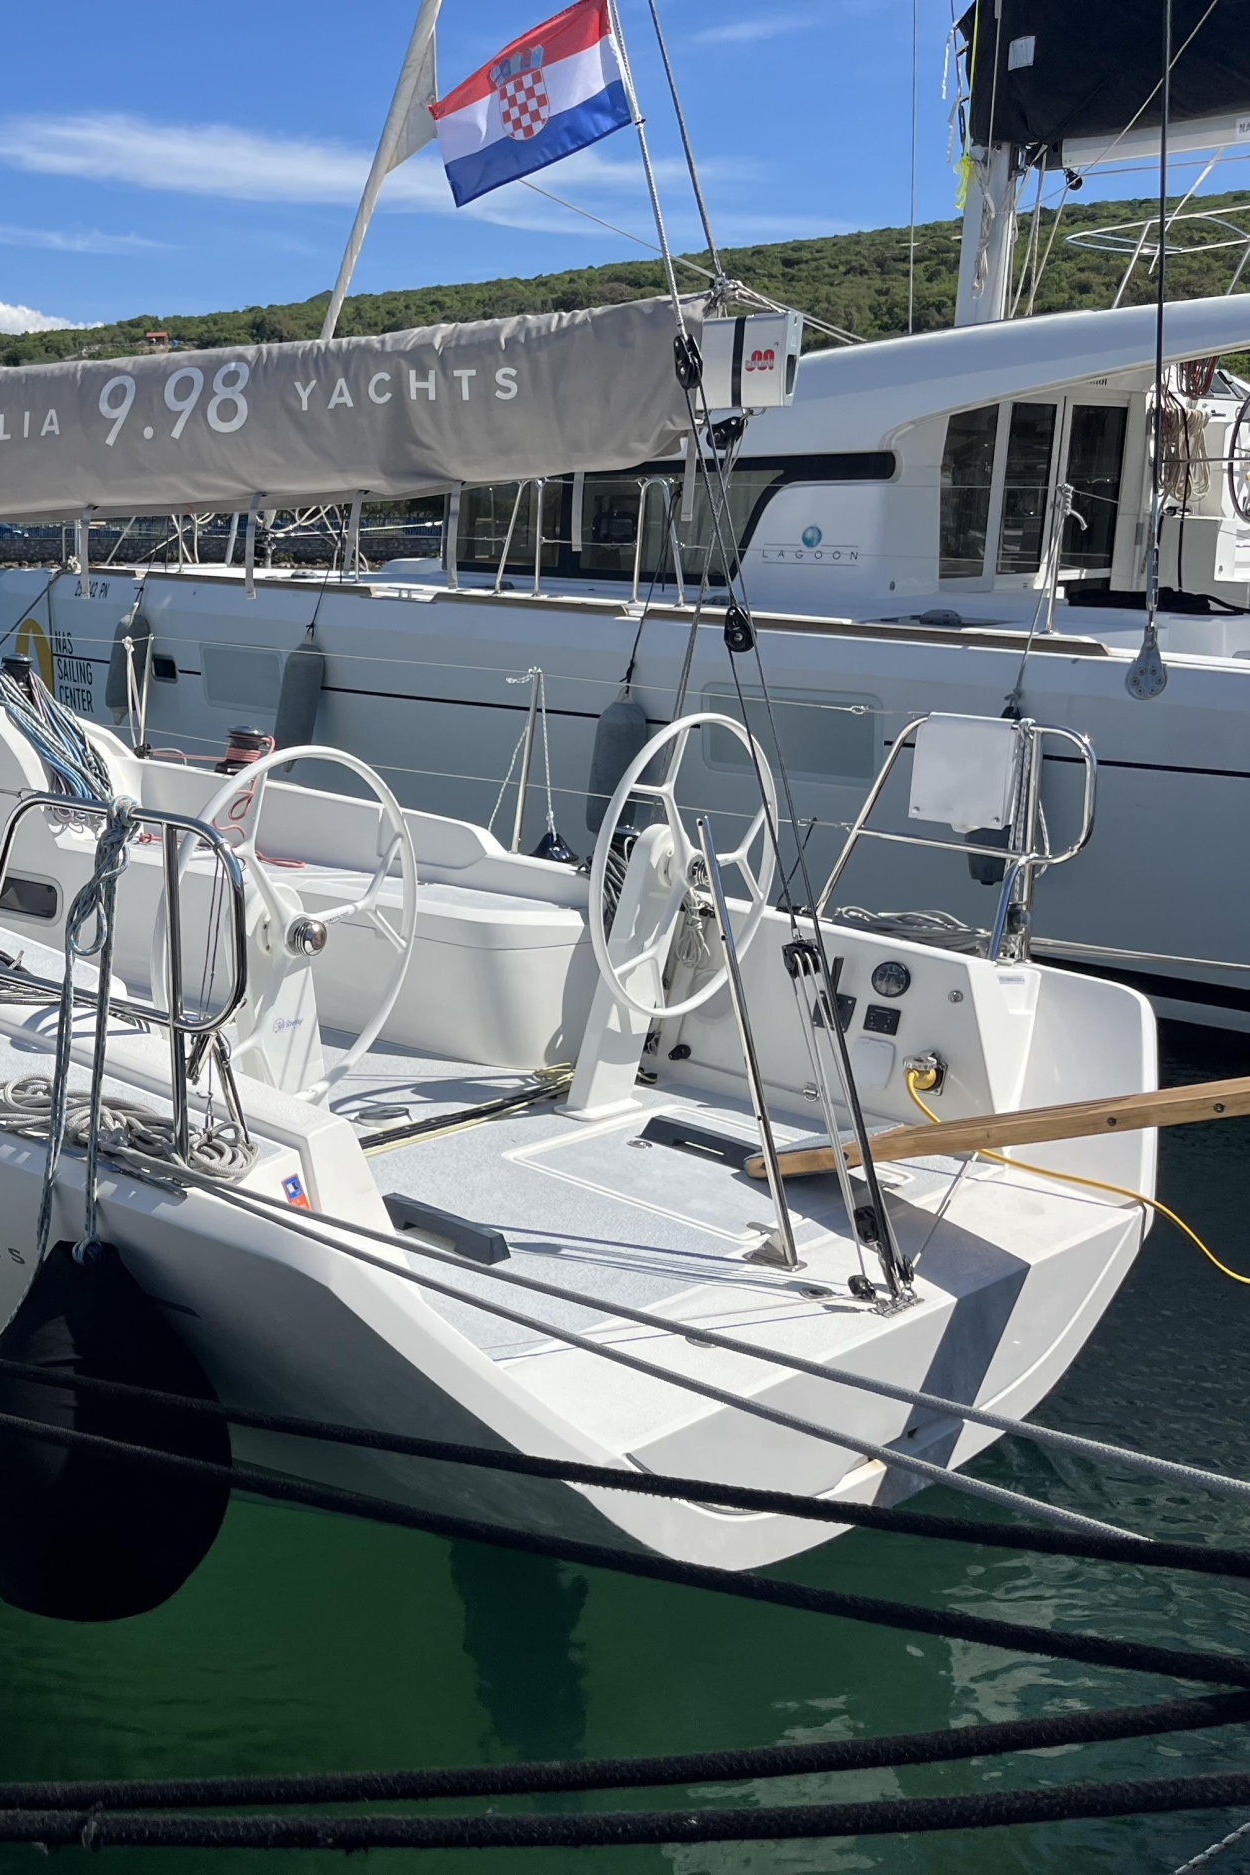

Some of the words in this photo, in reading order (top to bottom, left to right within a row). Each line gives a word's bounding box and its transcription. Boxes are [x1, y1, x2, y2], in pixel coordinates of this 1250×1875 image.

[98, 361, 250, 447] 9.98
[294, 367, 518, 411] YACHTS
[762, 549, 858, 561] LAGOON
[55, 630, 74, 655] NAS
[57, 658, 93, 685] SAILING
[59, 685, 94, 713] CENTER
